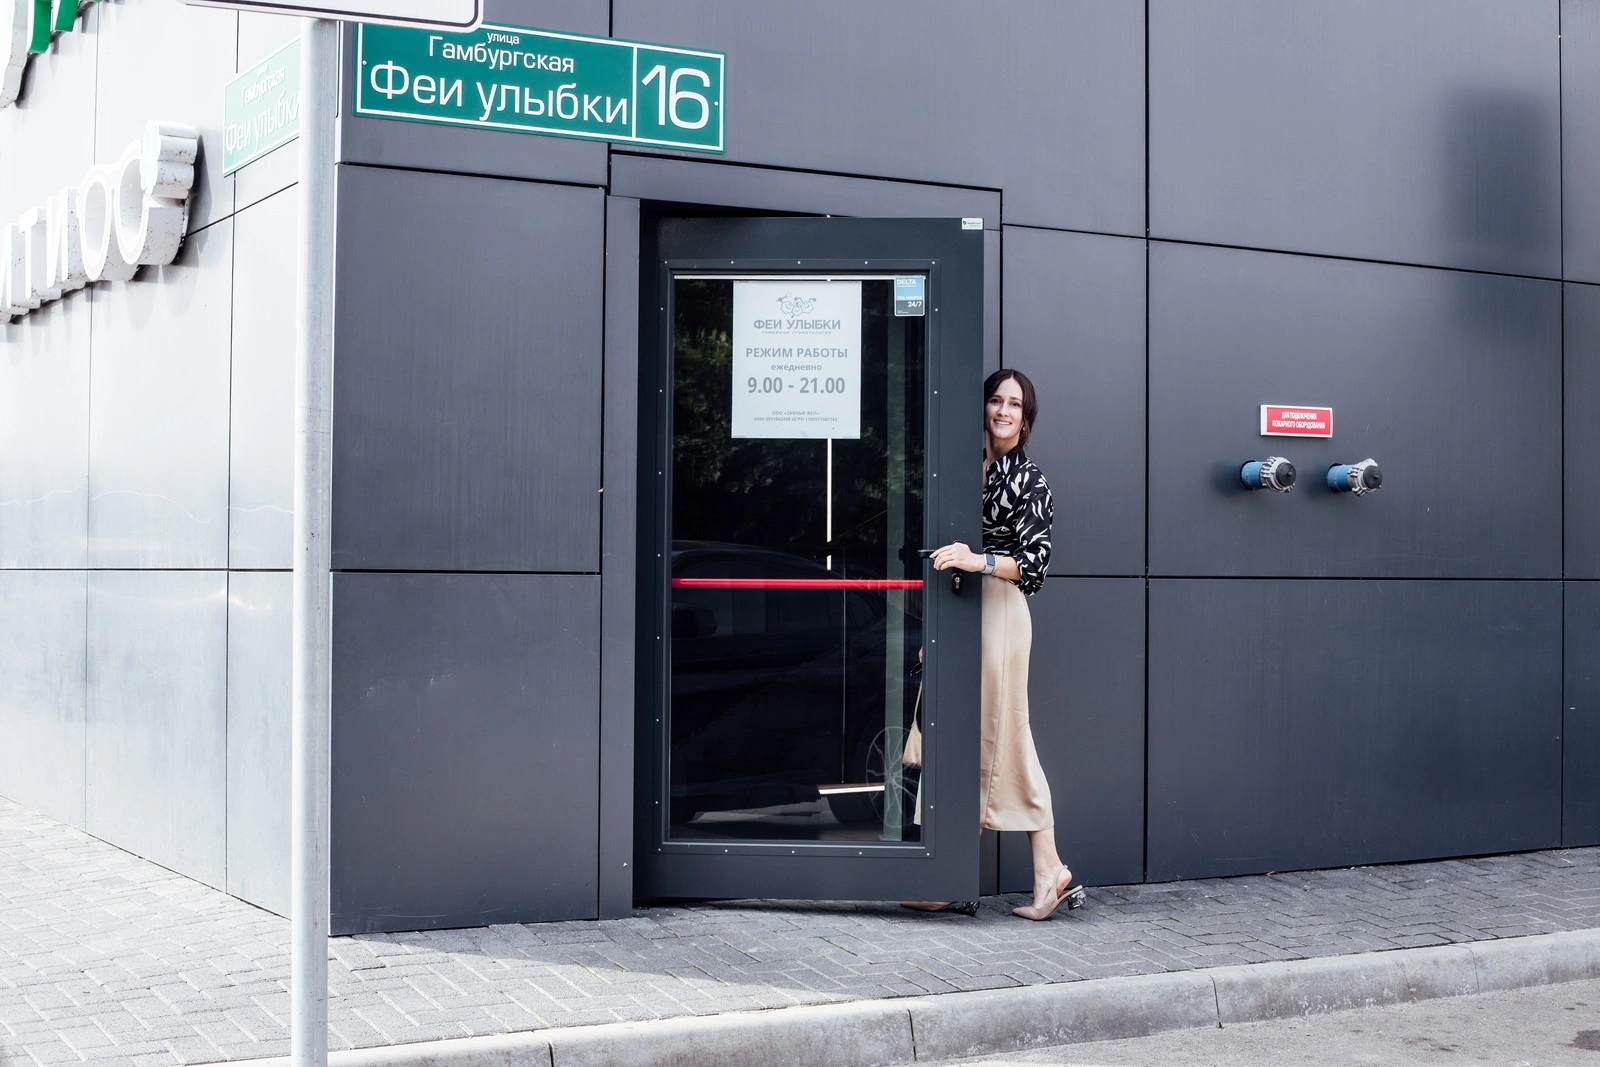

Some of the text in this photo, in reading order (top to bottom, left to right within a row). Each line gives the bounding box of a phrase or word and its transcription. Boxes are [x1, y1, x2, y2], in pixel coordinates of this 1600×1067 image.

[487, 31, 520, 46] улица
[429, 35, 575, 74] Гамбургская
[370, 60, 628, 125] Феи улыбки
[641, 64, 711, 130] 16
[225, 120, 252, 155] Феи
[753, 319, 841, 330] ФЕИ УЛЫБКИ
[745, 347, 848, 358] РЕЖИМ РАБОТЫ
[770, 364, 822, 372] ежедневно
[747, 377, 783, 394] 9.00
[799, 377, 846, 394] 21.00
